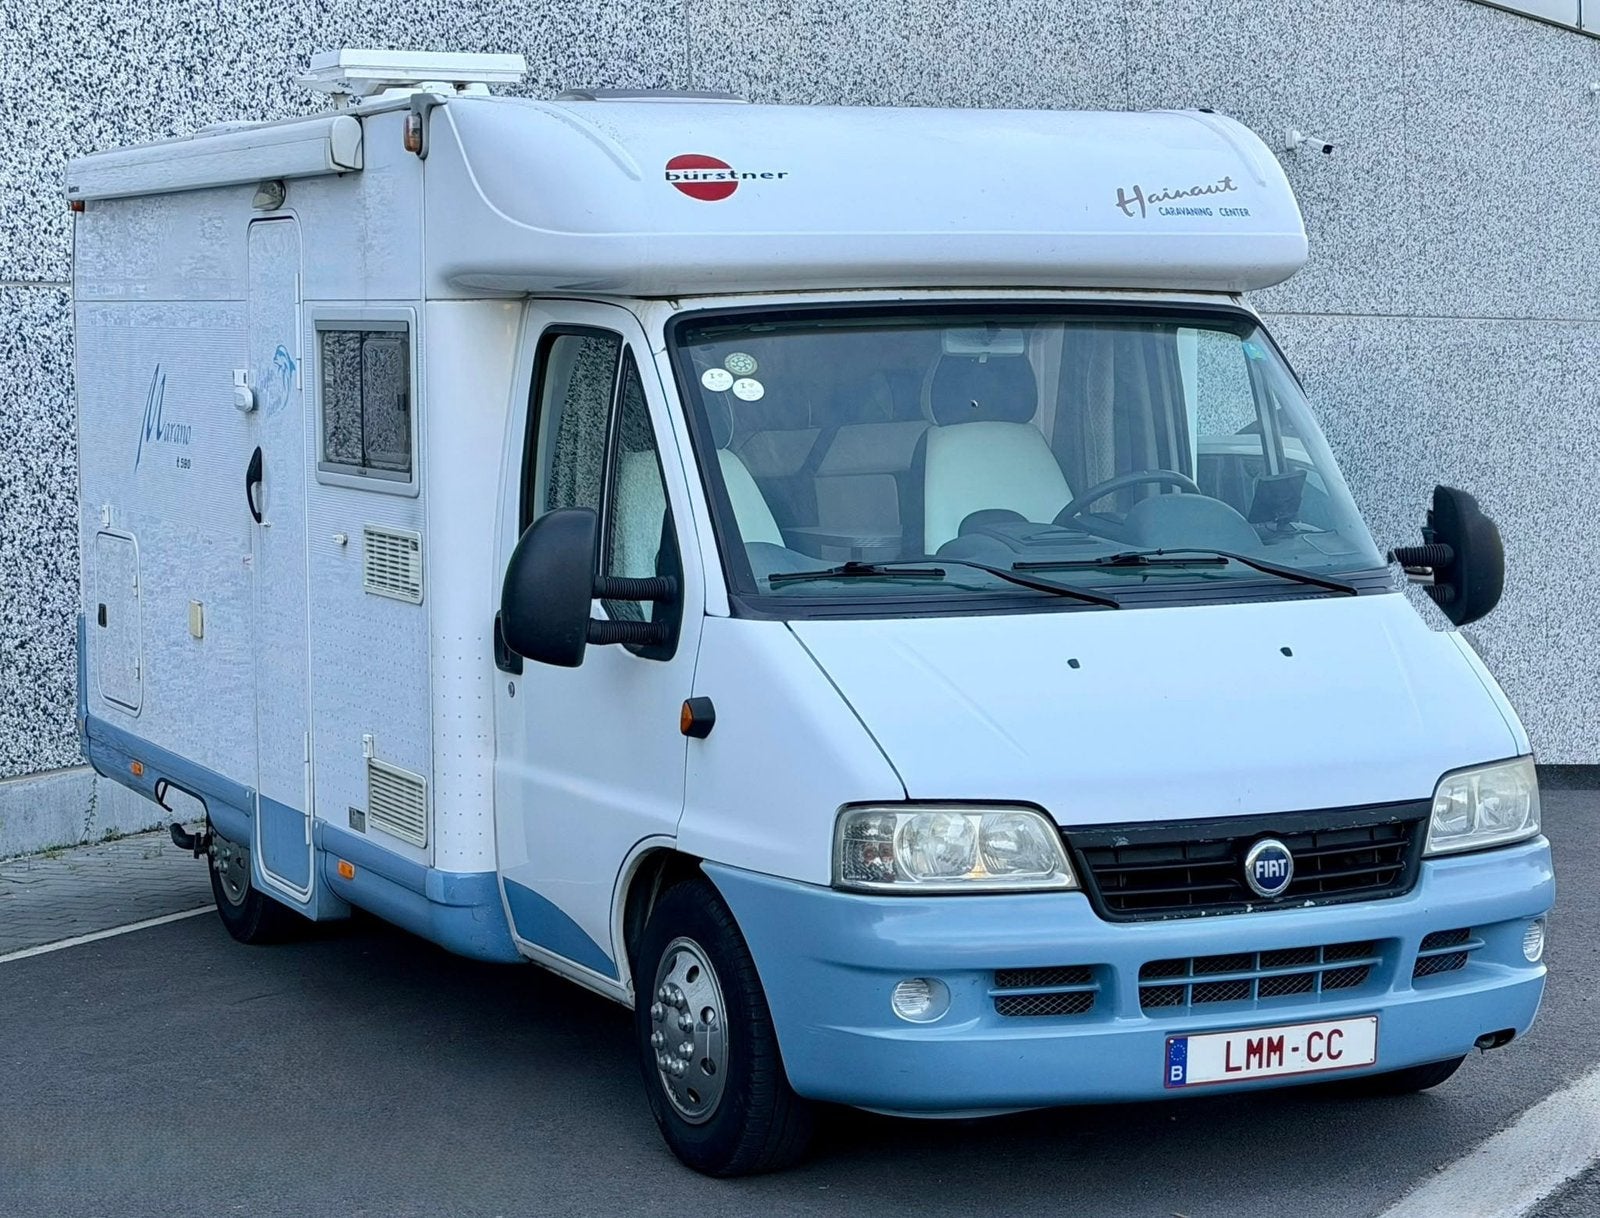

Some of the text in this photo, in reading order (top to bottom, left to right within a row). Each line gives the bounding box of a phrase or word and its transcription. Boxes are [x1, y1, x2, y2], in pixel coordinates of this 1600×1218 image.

[665, 170, 789, 181] bürstner
[1116, 176, 1238, 219] Hainaut
[1158, 207, 1251, 217] CARAVANING CENTER
[134, 363, 192, 474] Marano
[1255, 859, 1287, 879] FIAT
[1225, 1029, 1344, 1073] LMM-CC
[1170, 1066, 1183, 1081] B
